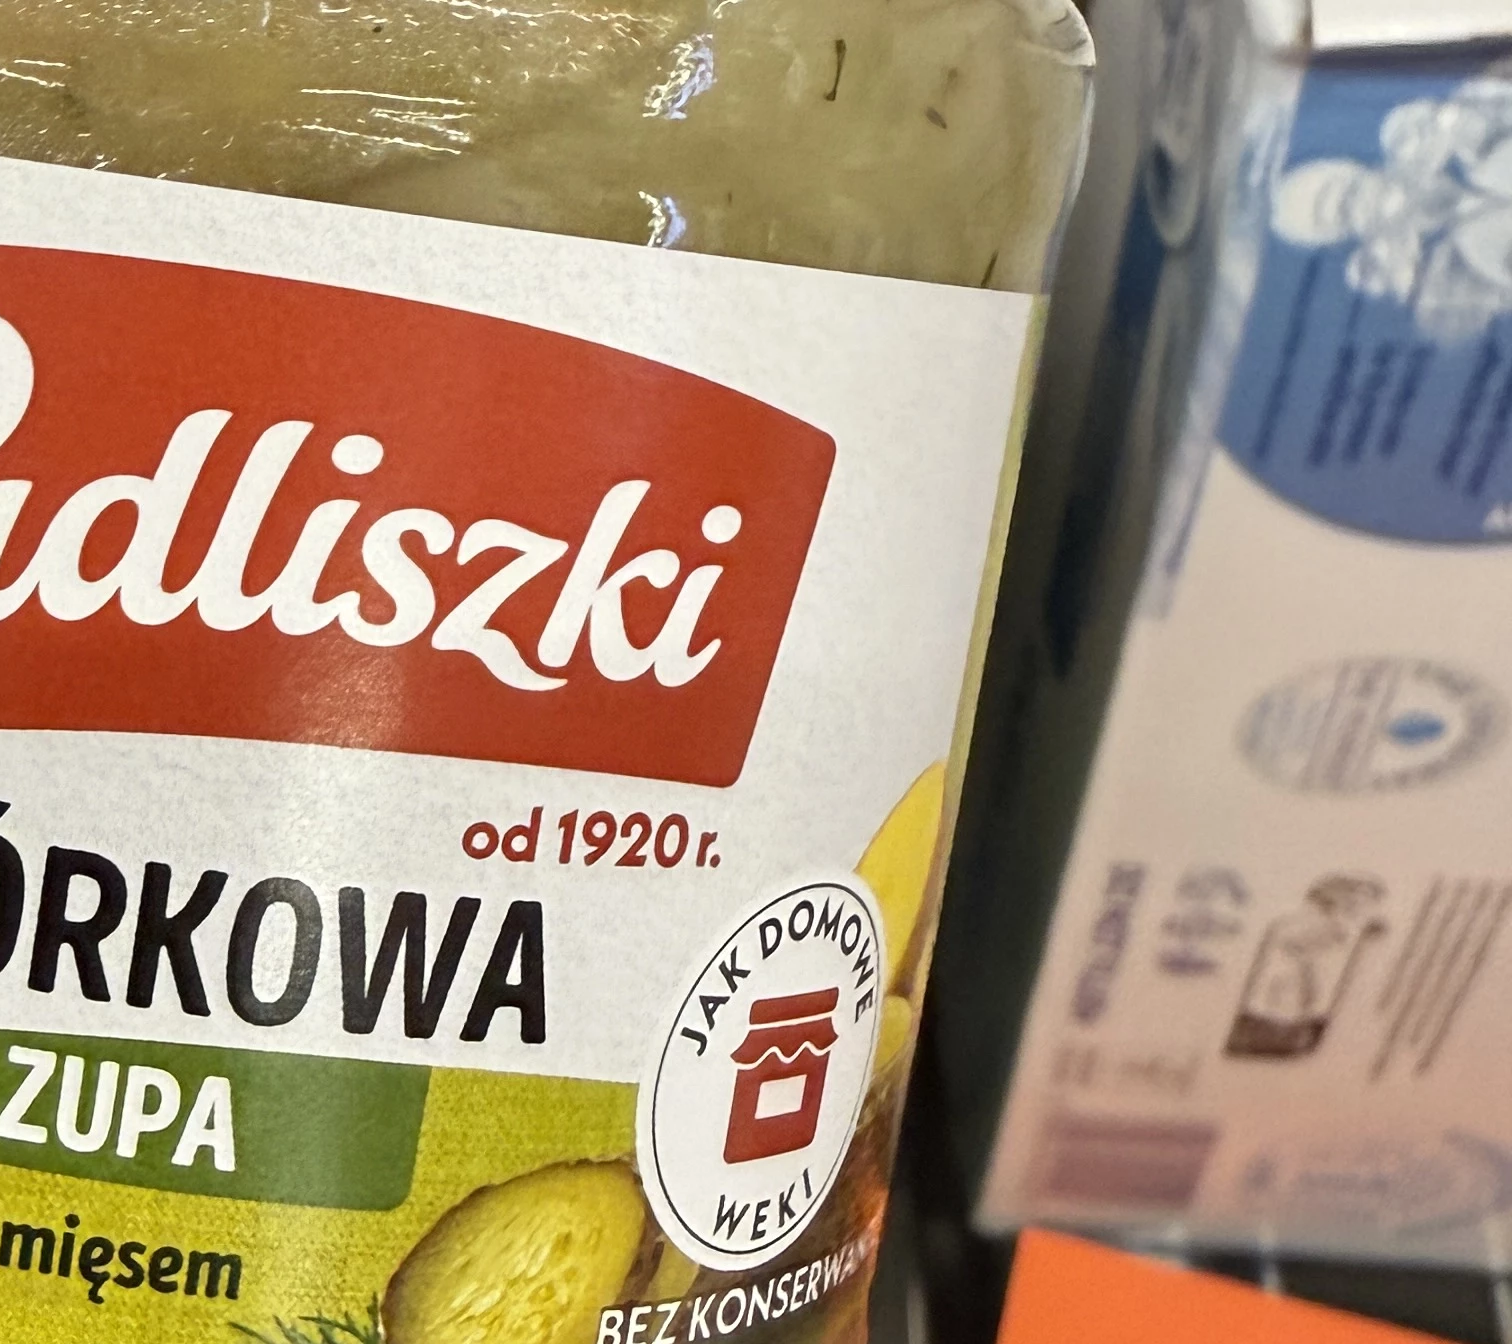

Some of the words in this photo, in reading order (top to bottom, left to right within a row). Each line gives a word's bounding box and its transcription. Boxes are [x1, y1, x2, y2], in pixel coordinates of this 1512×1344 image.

[462, 807, 543, 863] od
[680, 953, 751, 1056] JAK
[758, 895, 880, 1024] DOMOWE
[712, 1167, 812, 1242] WEKI
[0, 1213, 243, 1304] mięsem
